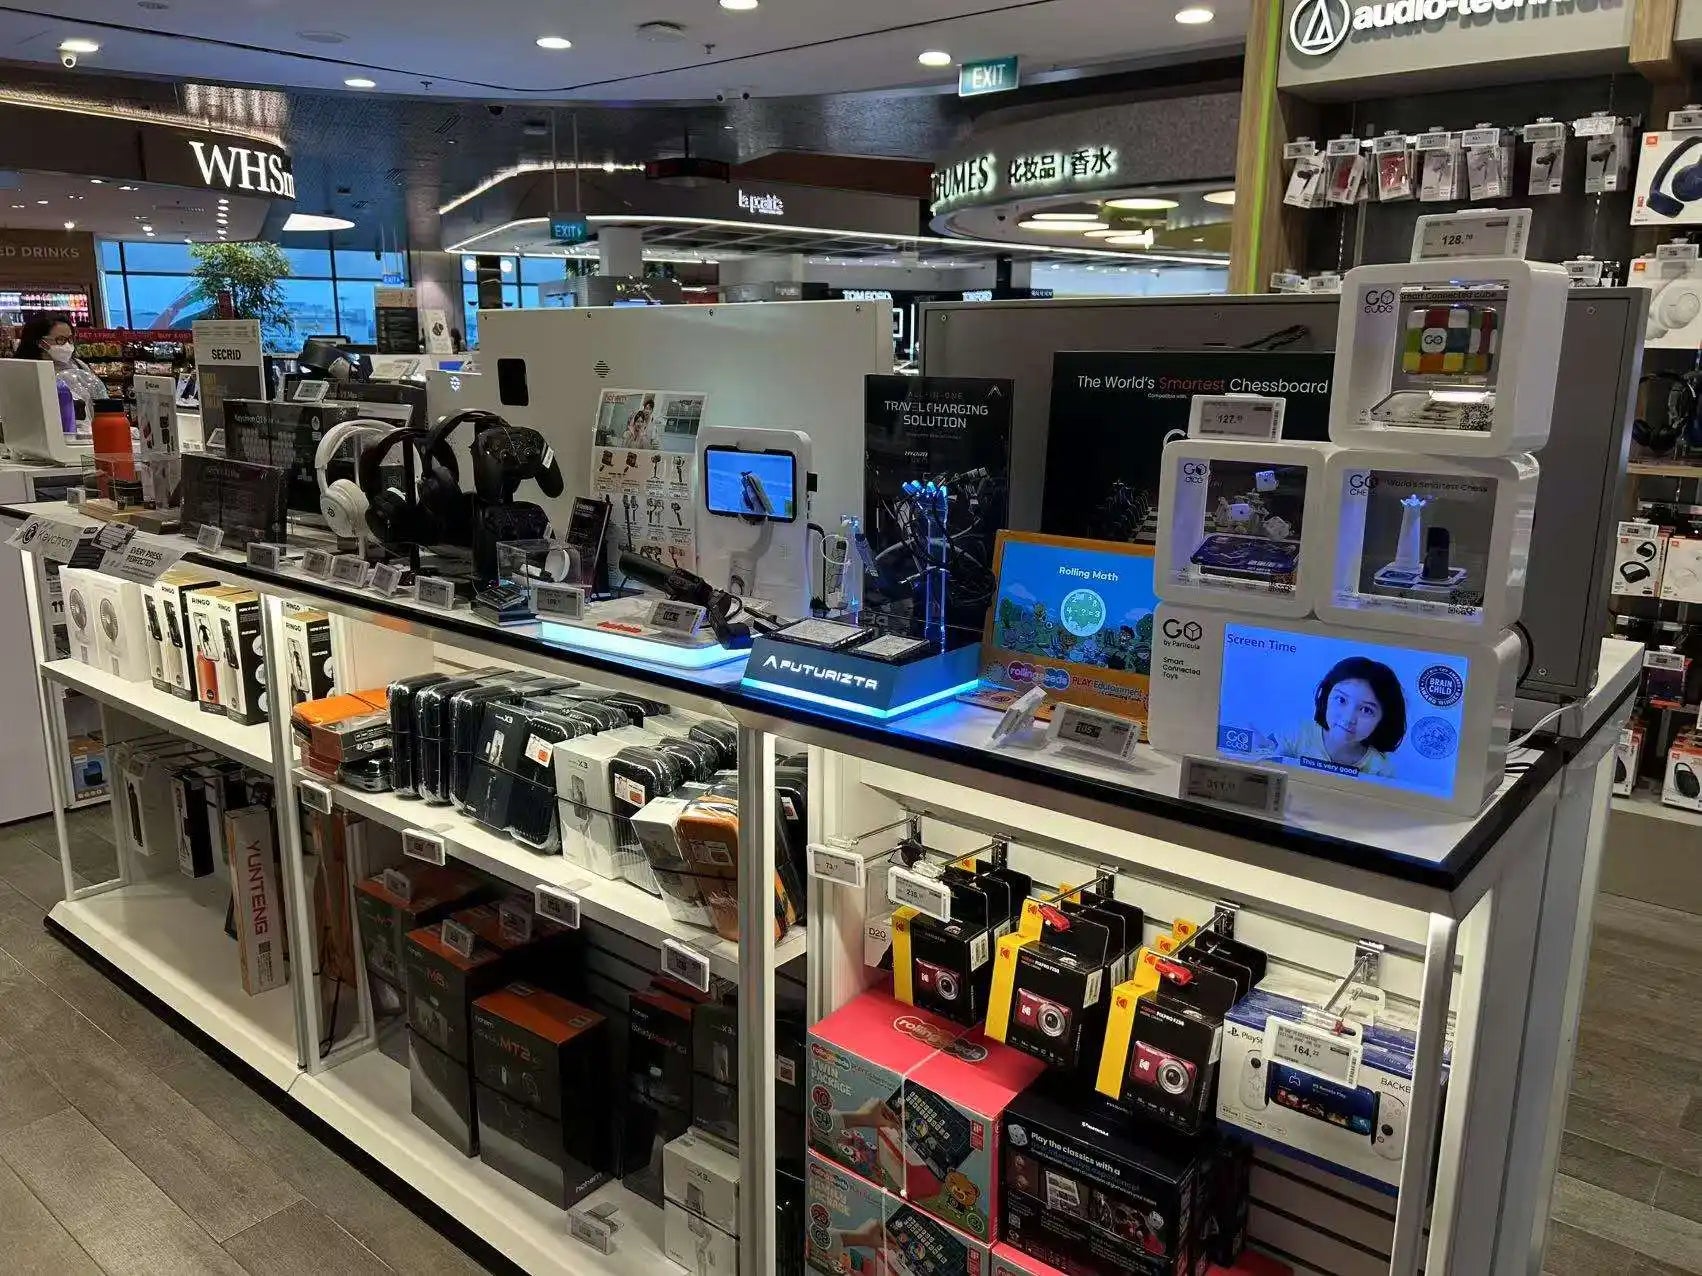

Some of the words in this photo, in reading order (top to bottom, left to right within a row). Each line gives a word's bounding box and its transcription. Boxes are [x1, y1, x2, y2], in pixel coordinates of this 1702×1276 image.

[972, 64, 1006, 88] EXIT
[1008, 154, 1055, 185] 化妆品
[1071, 147, 1112, 177] 香水
[554, 224, 578, 237] EXIT
[21, 246, 80, 258] DRINKS
[1365, 289, 1395, 305] GO
[211, 348, 242, 361] SECRID
[1077, 375, 1101, 388] The
[1105, 375, 1155, 389] World's
[1159, 377, 1225, 391] Smartest
[1229, 378, 1329, 394] Chessboard
[884, 400, 925, 412] TRAVEL
[926, 402, 989, 416] CHARGING
[903, 414, 967, 429] SOLUTION
[1059, 566, 1089, 579] Rolling
[1092, 571, 1119, 581] Math
[1162, 618, 1203, 642] GO
[1172, 641, 1200, 650] Particula
[1227, 633, 1265, 648] Screen
[1269, 639, 1297, 653] Time
[1163, 656, 1184, 666] Smart
[1162, 664, 1201, 675] Connected
[1162, 672, 1179, 680] Toys
[1428, 685, 1452, 695] CHILD
[1429, 678, 1453, 687] BRAIN
[1302, 757, 1316, 767] This
[1324, 763, 1339, 772] very
[1339, 766, 1358, 775] good
[245, 839, 269, 936] YUNTENG
[811, 1069, 852, 1096] PACKAGE
[1031, 1131, 1049, 1148] Play
[1049, 1140, 1062, 1151] the
[1062, 1146, 1095, 1166] classics
[1095, 1160, 1113, 1173] with
